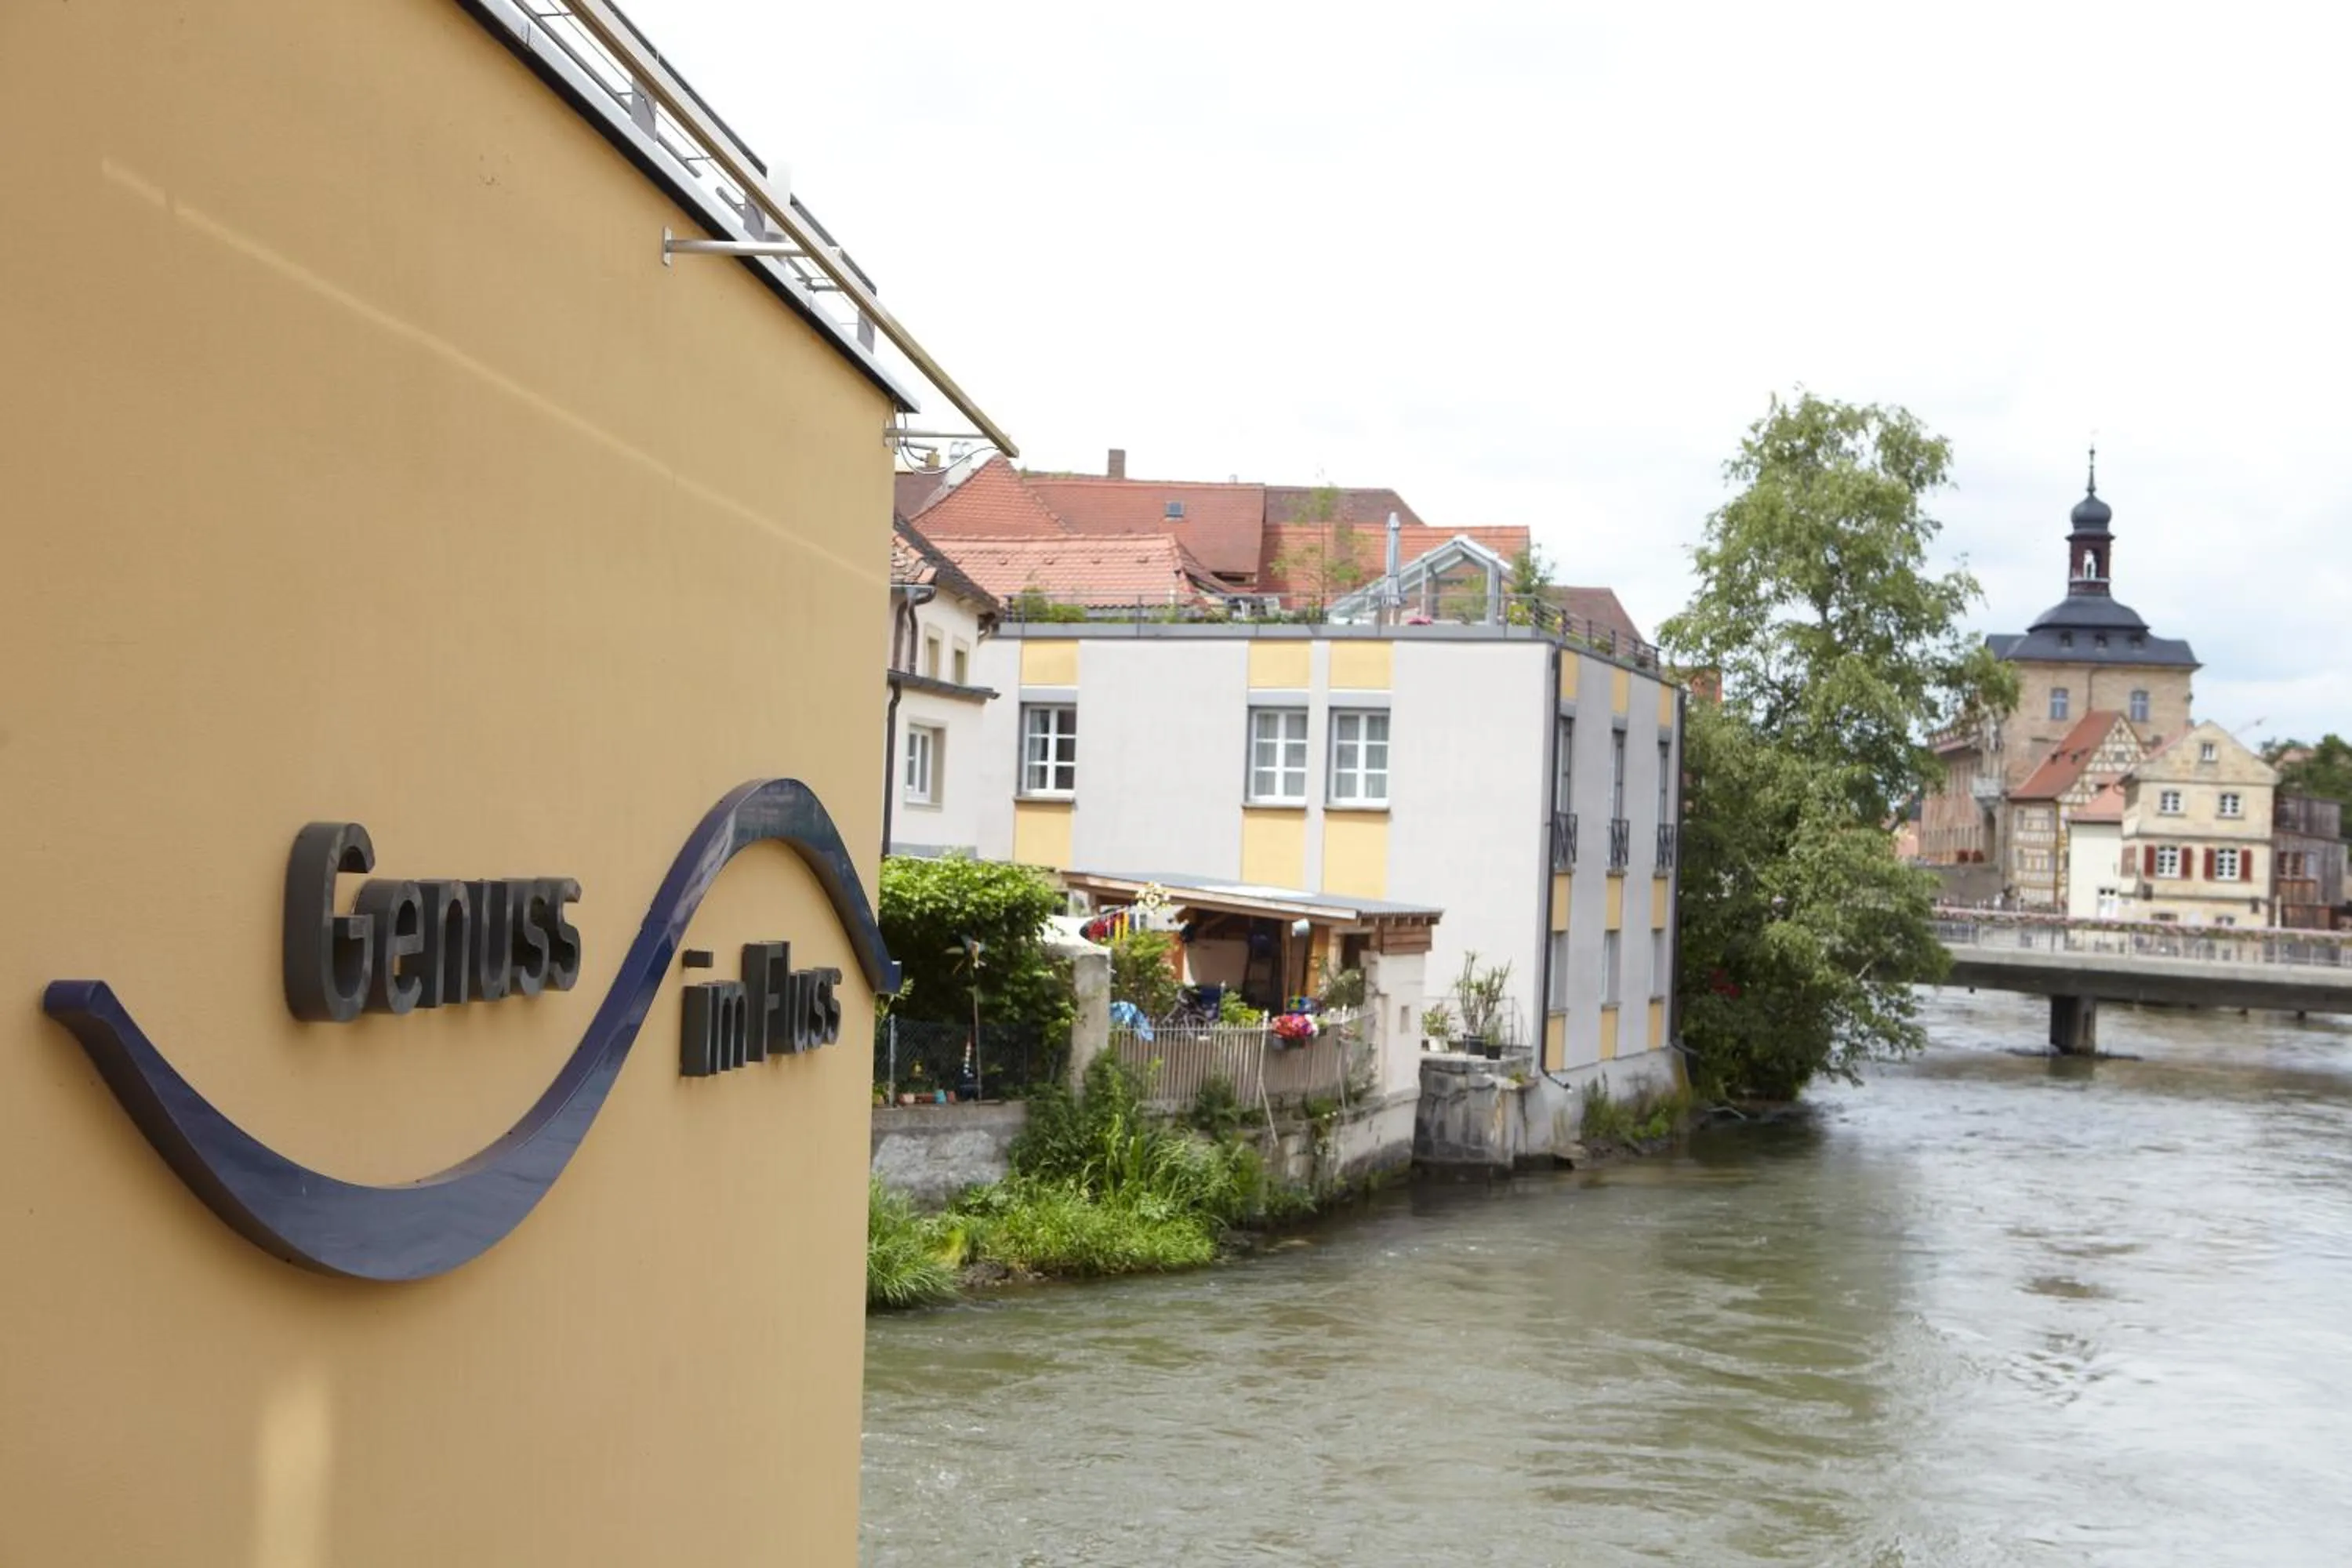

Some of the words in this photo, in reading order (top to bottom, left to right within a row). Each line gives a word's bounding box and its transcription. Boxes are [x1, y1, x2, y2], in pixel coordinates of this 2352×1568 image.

[283, 821, 582, 1022] Genuss
[681, 949, 746, 1077] im
[741, 941, 843, 1062] Fluss
